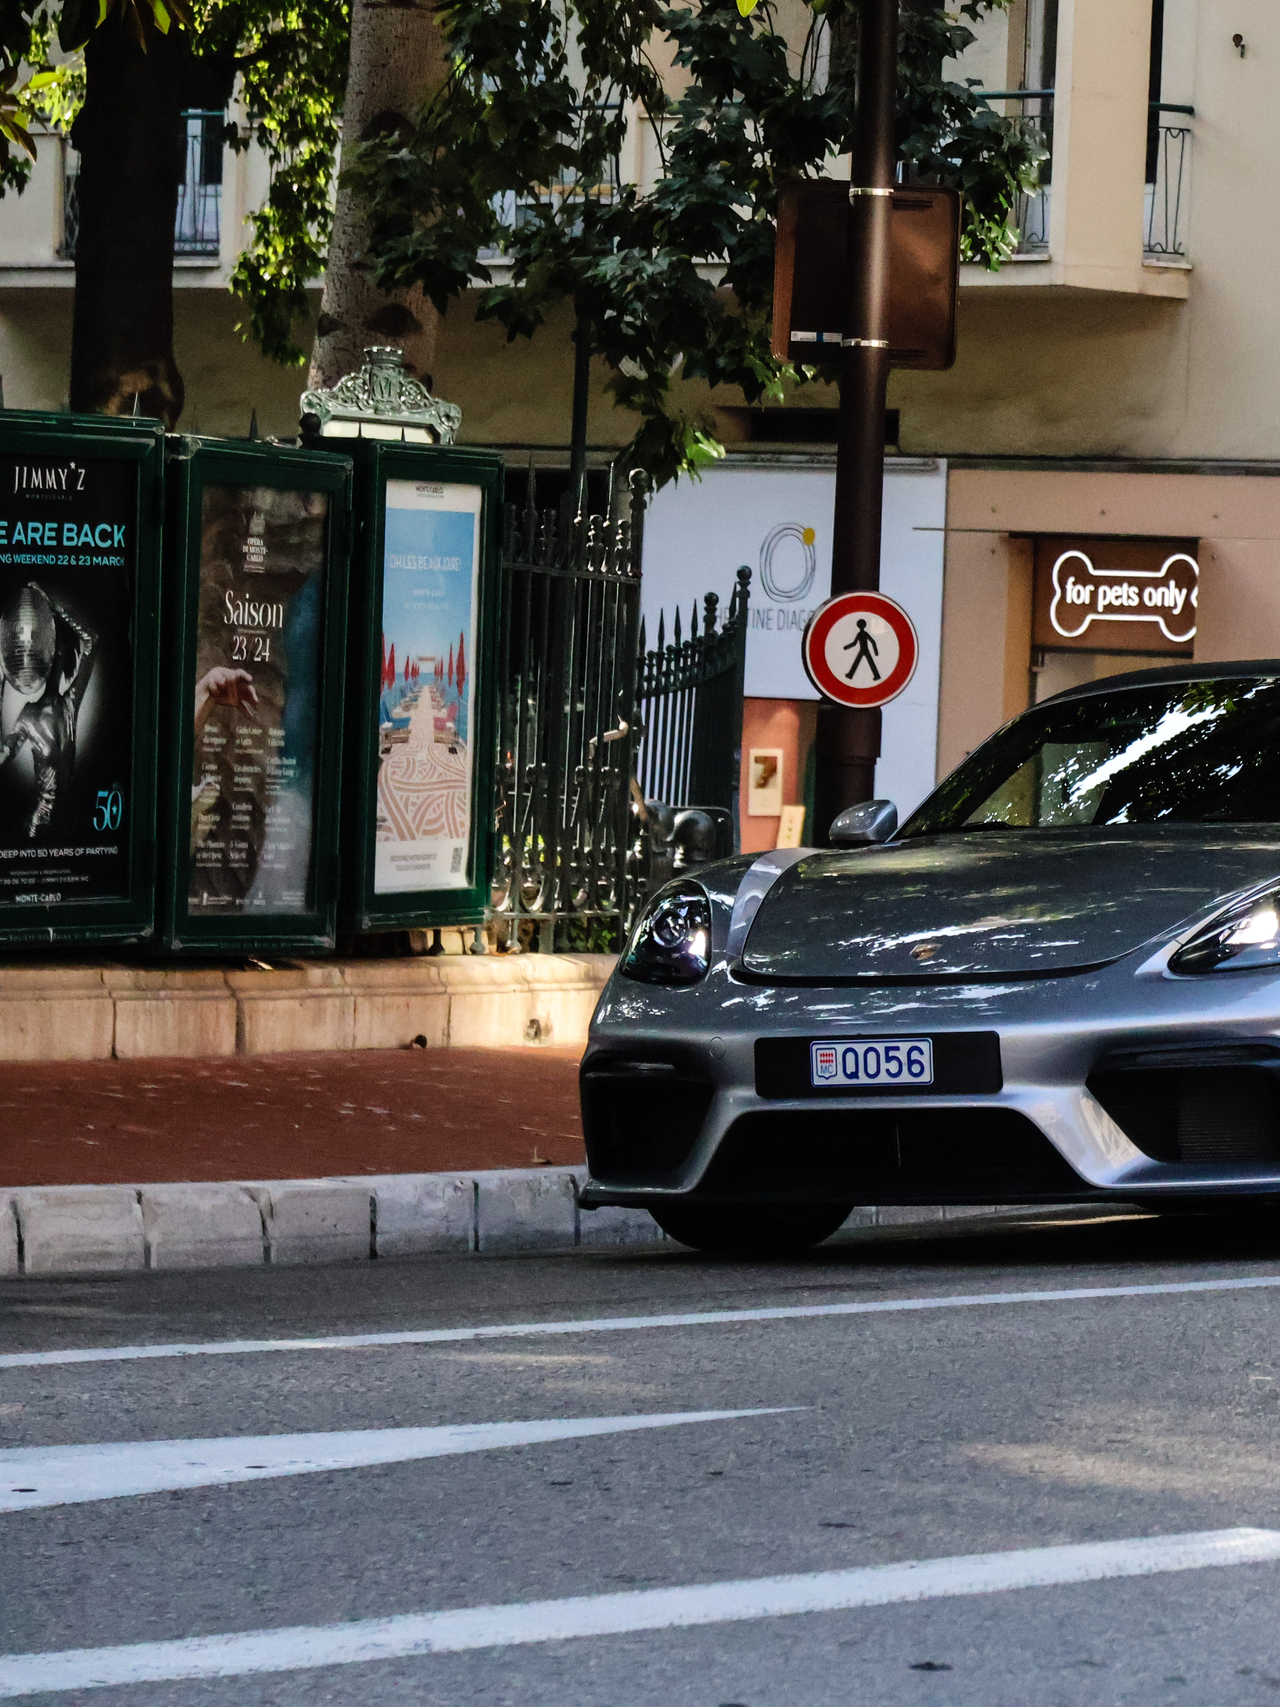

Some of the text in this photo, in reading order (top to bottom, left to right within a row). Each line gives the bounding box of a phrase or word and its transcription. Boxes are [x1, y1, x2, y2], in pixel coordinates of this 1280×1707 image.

[12, 521, 58, 546] ARE
[62, 523, 126, 548] BACK
[13, 554, 56, 565] WEEKEND
[57, 555, 69, 565] 22
[70, 556, 77, 565] &
[78, 556, 91, 566] 23
[403, 556, 417, 569] LES
[418, 556, 441, 570] BEAUX
[1065, 576, 1188, 615] for pets only
[224, 590, 283, 628] Saison
[93, 790, 122, 831] 50
[19, 849, 36, 858] INTO
[37, 849, 48, 858] 50
[49, 848, 74, 857] YEARS
[75, 848, 85, 856] OF
[86, 846, 118, 855] PARTYING
[820, 1065, 834, 1075] MC
